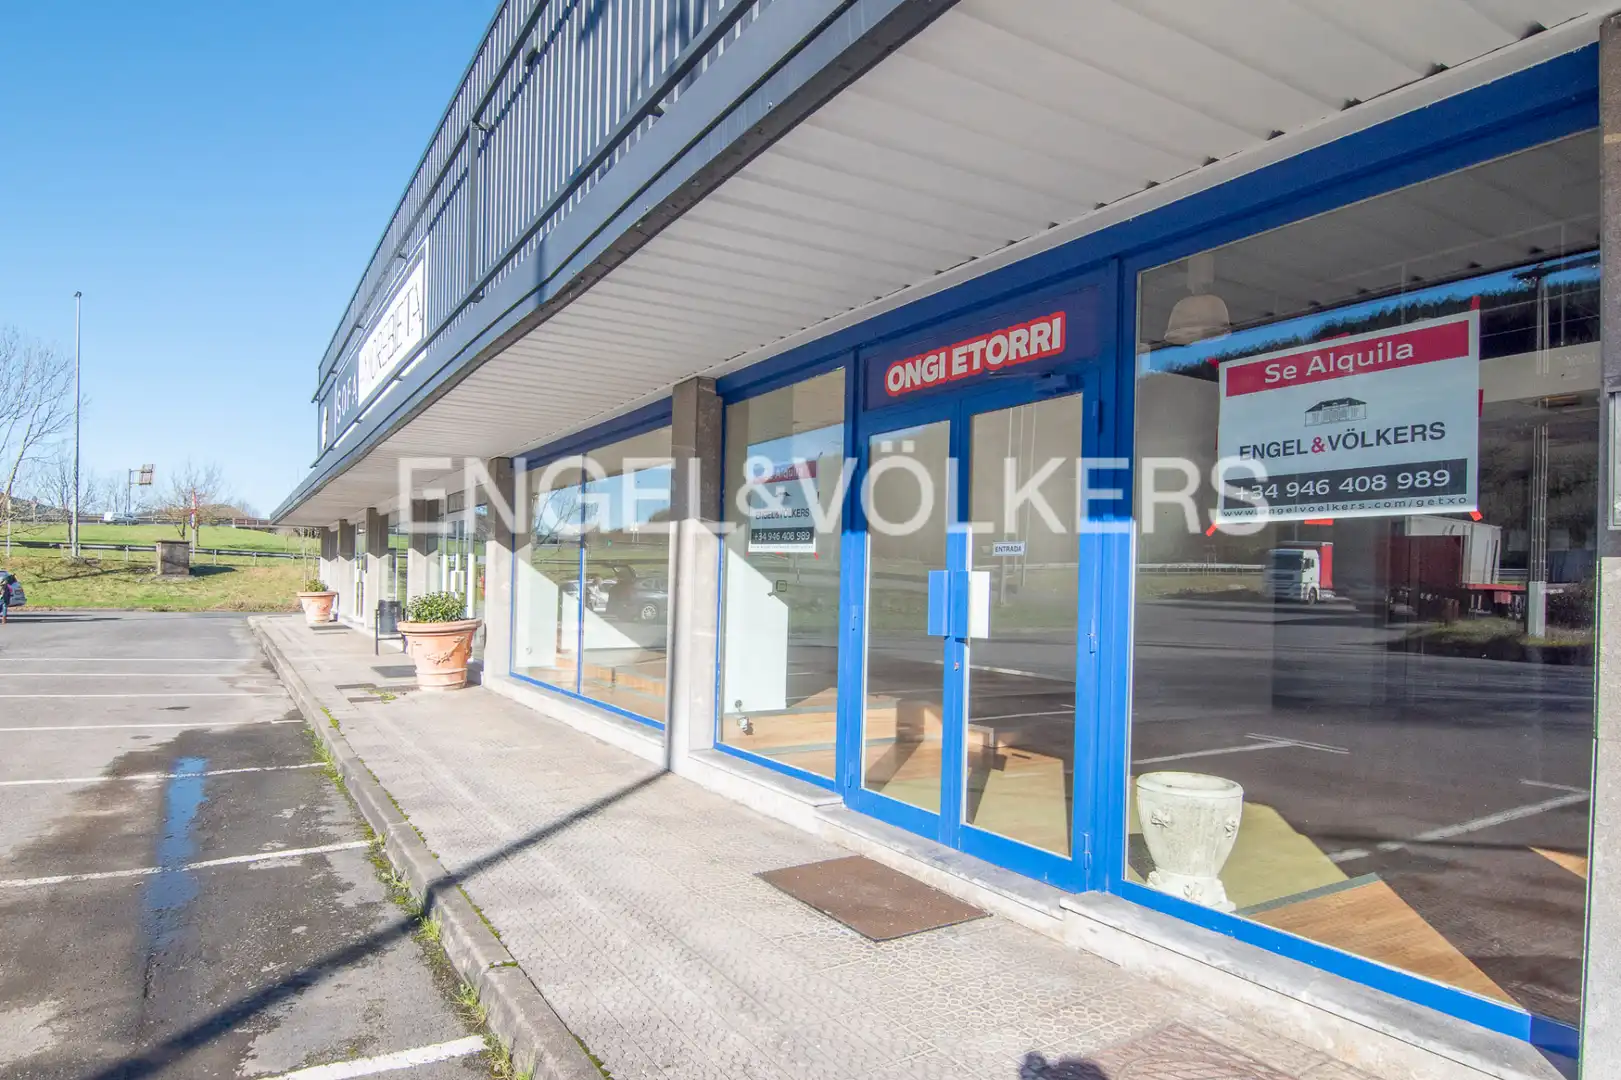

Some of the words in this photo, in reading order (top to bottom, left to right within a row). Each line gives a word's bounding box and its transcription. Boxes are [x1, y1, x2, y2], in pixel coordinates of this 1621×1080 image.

[887, 352, 946, 392] ONGI
[951, 317, 1061, 376] ETORRI
[1264, 363, 1297, 384] Se
[1306, 341, 1414, 377] Alquila
[1235, 482, 1278, 501] +34
[1286, 478, 1330, 498] 946
[1338, 474, 1387, 495] 408
[1397, 469, 1450, 490] 989
[767, 531, 781, 541] 946
[781, 531, 795, 541] 408
[796, 531, 810, 541] 989
[994, 545, 1022, 553] ENTRADA
